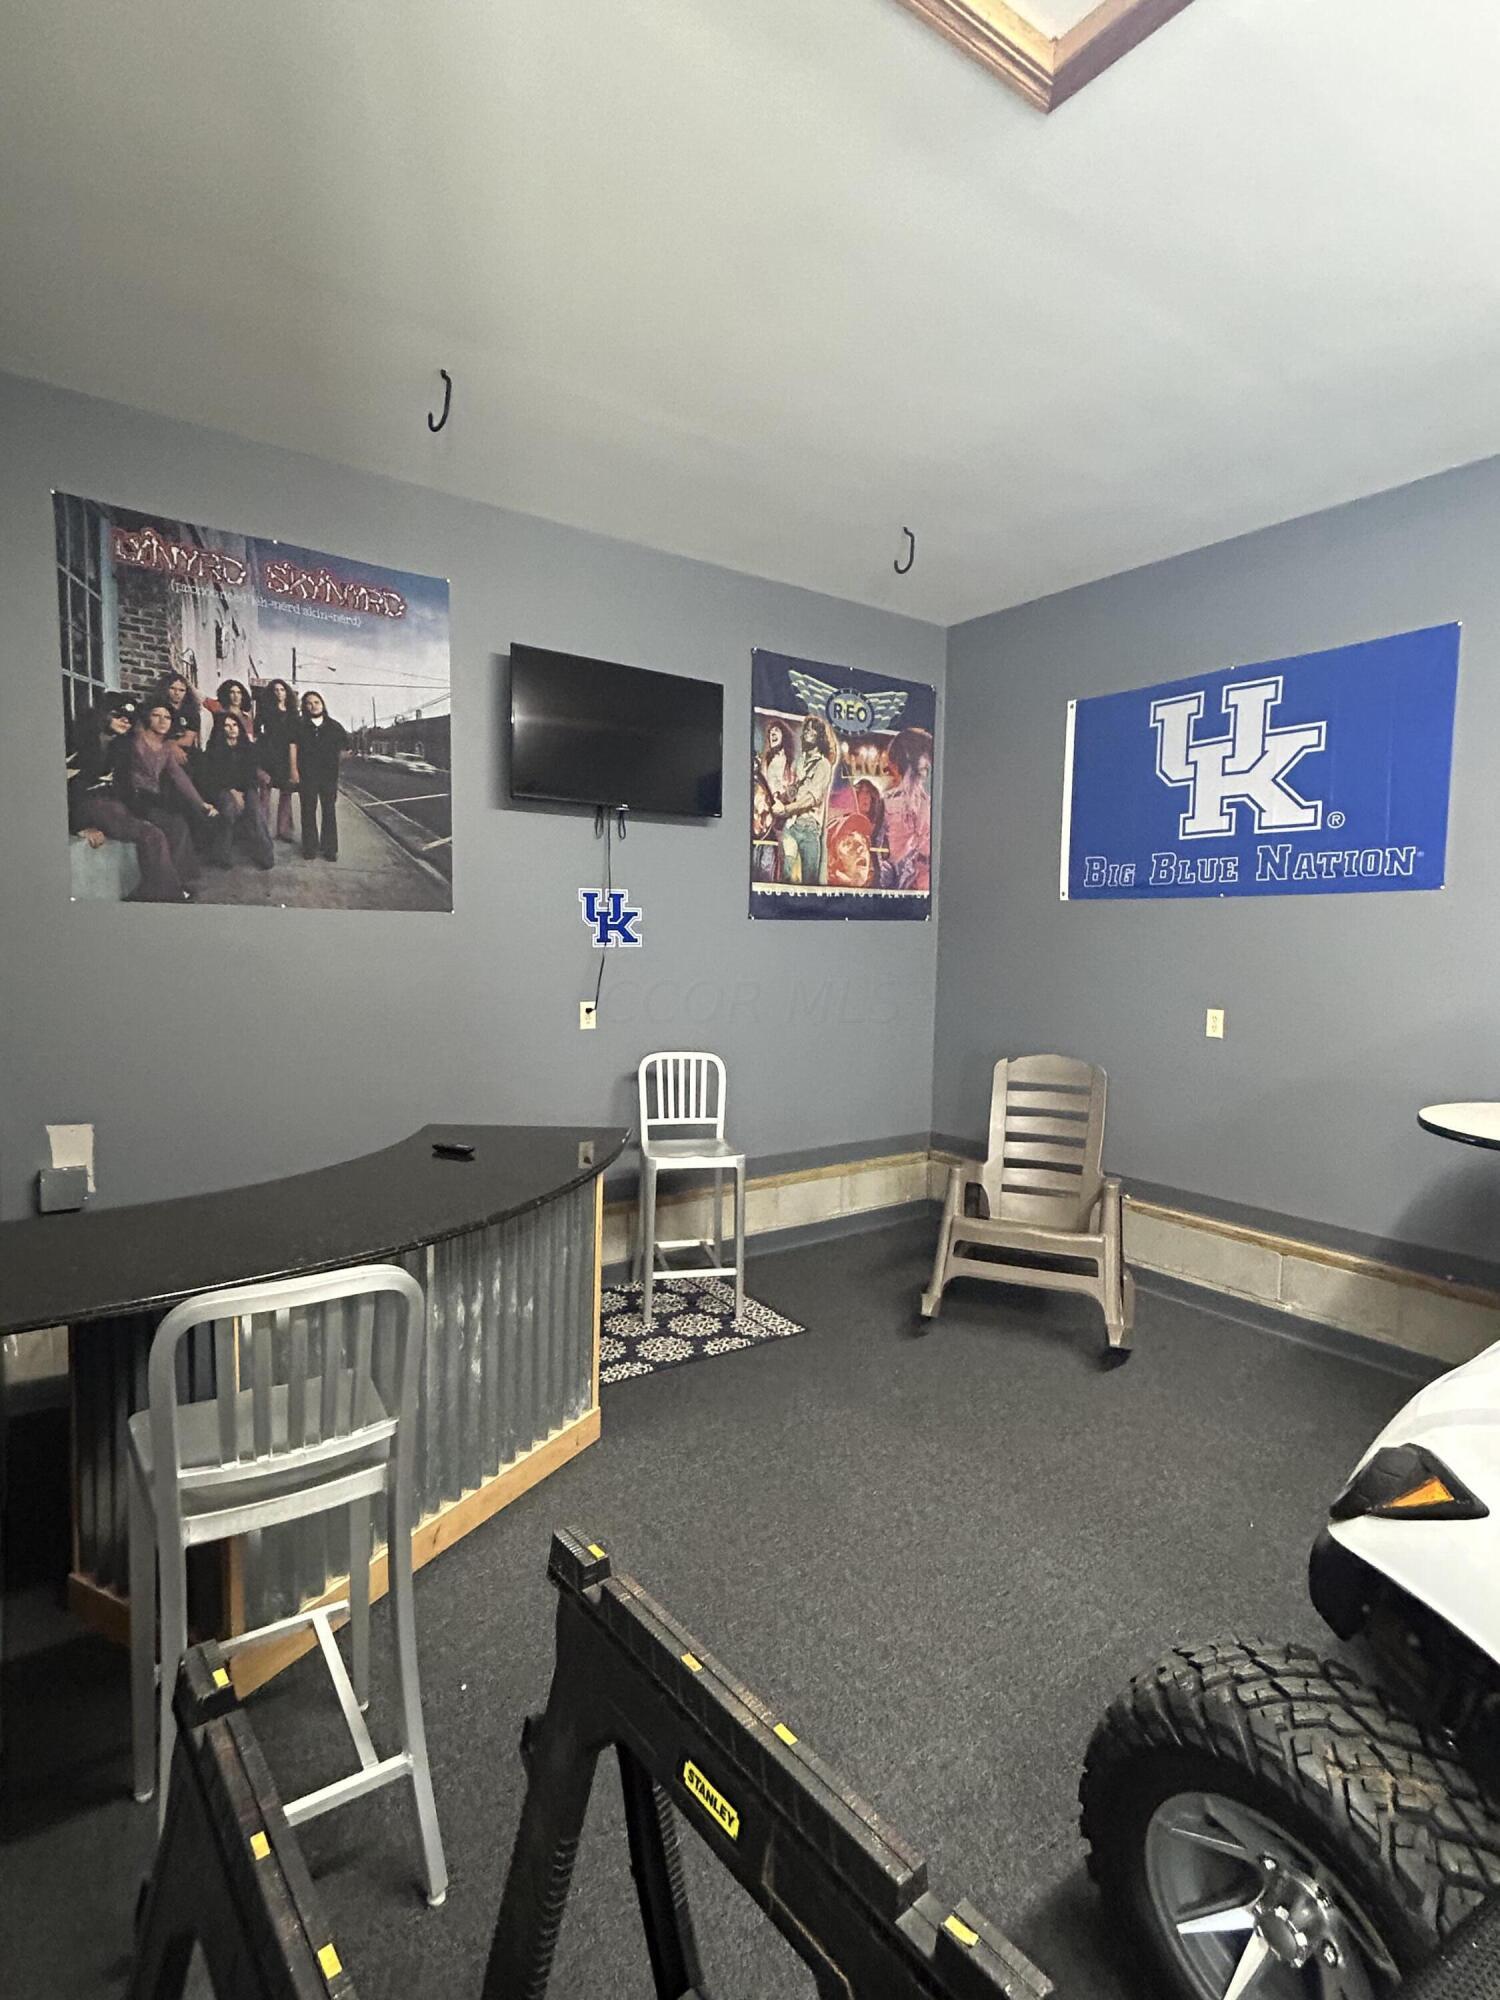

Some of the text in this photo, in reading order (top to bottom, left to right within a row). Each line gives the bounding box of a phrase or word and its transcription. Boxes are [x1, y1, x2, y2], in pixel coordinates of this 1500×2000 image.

[833, 703, 868, 722] REO
[1150, 676, 1327, 840] UK
[1084, 844, 1417, 888] BIG BLUE NATION
[578, 888, 643, 947] UK
[687, 1768, 736, 1828] STANLEY
